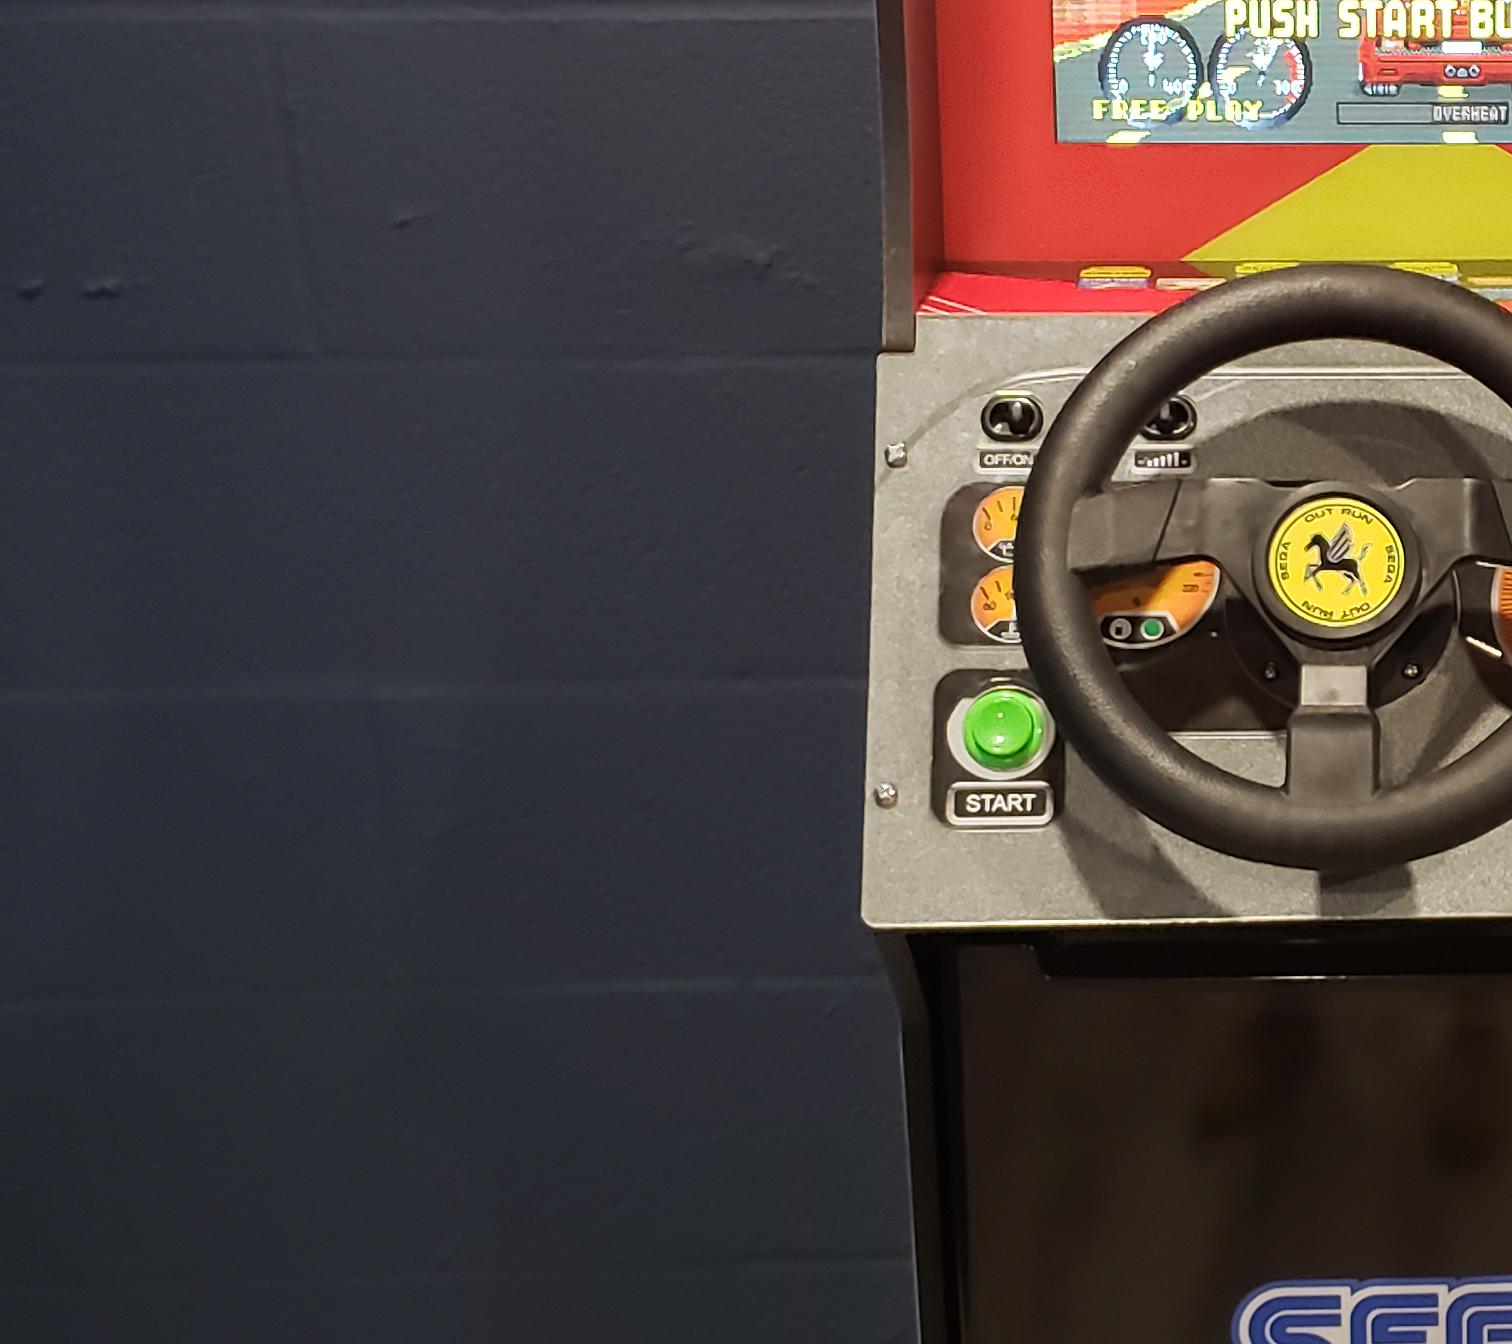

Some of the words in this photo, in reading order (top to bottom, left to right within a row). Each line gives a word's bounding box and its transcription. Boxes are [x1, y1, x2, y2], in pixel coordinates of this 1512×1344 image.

[1092, 98, 1168, 121] FREE
[1186, 98, 1263, 122] PLAY
[1433, 105, 1508, 123] OVERHEAT
[965, 793, 1038, 813] START
